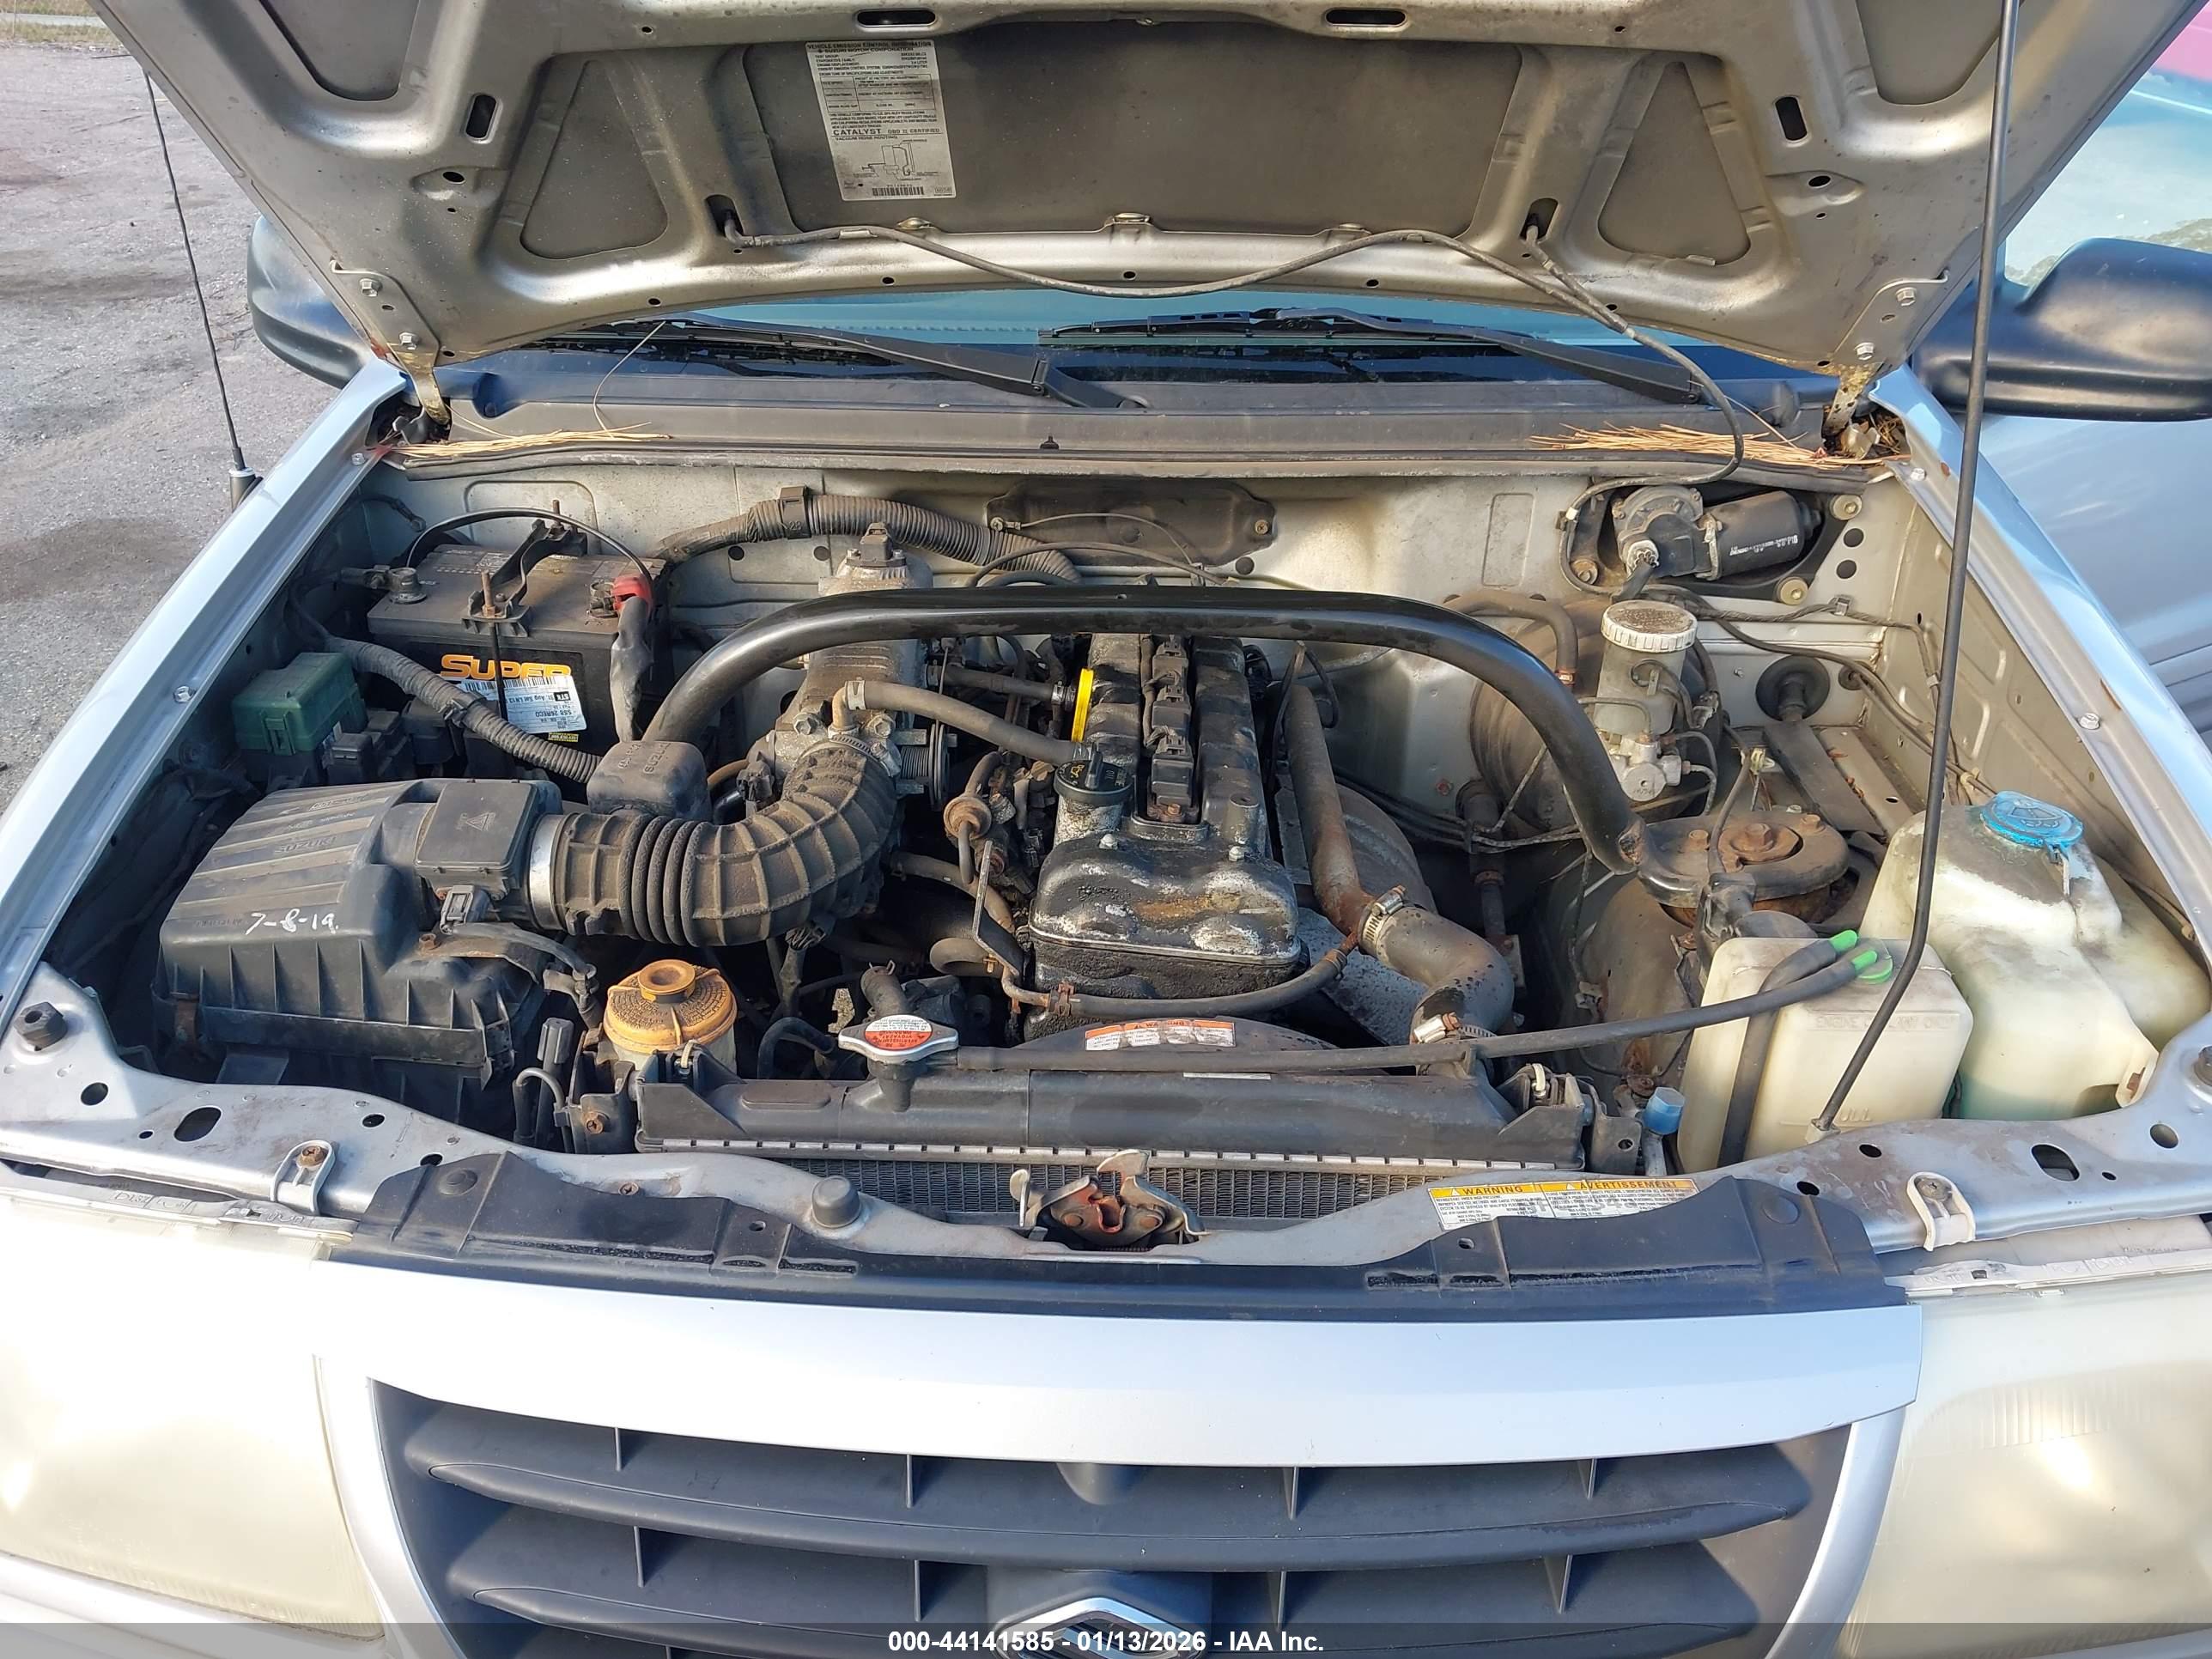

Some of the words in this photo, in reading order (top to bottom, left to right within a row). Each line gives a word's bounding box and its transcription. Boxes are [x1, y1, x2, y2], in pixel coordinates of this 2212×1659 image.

[441, 653, 572, 681] SUPER
[278, 836, 337, 853] SUZUKI
[1839, 1107, 1873, 1123] ULL
[1462, 1186, 1523, 1195] WARNING
[1580, 1181, 1679, 1190] AVERTISSEMENT
